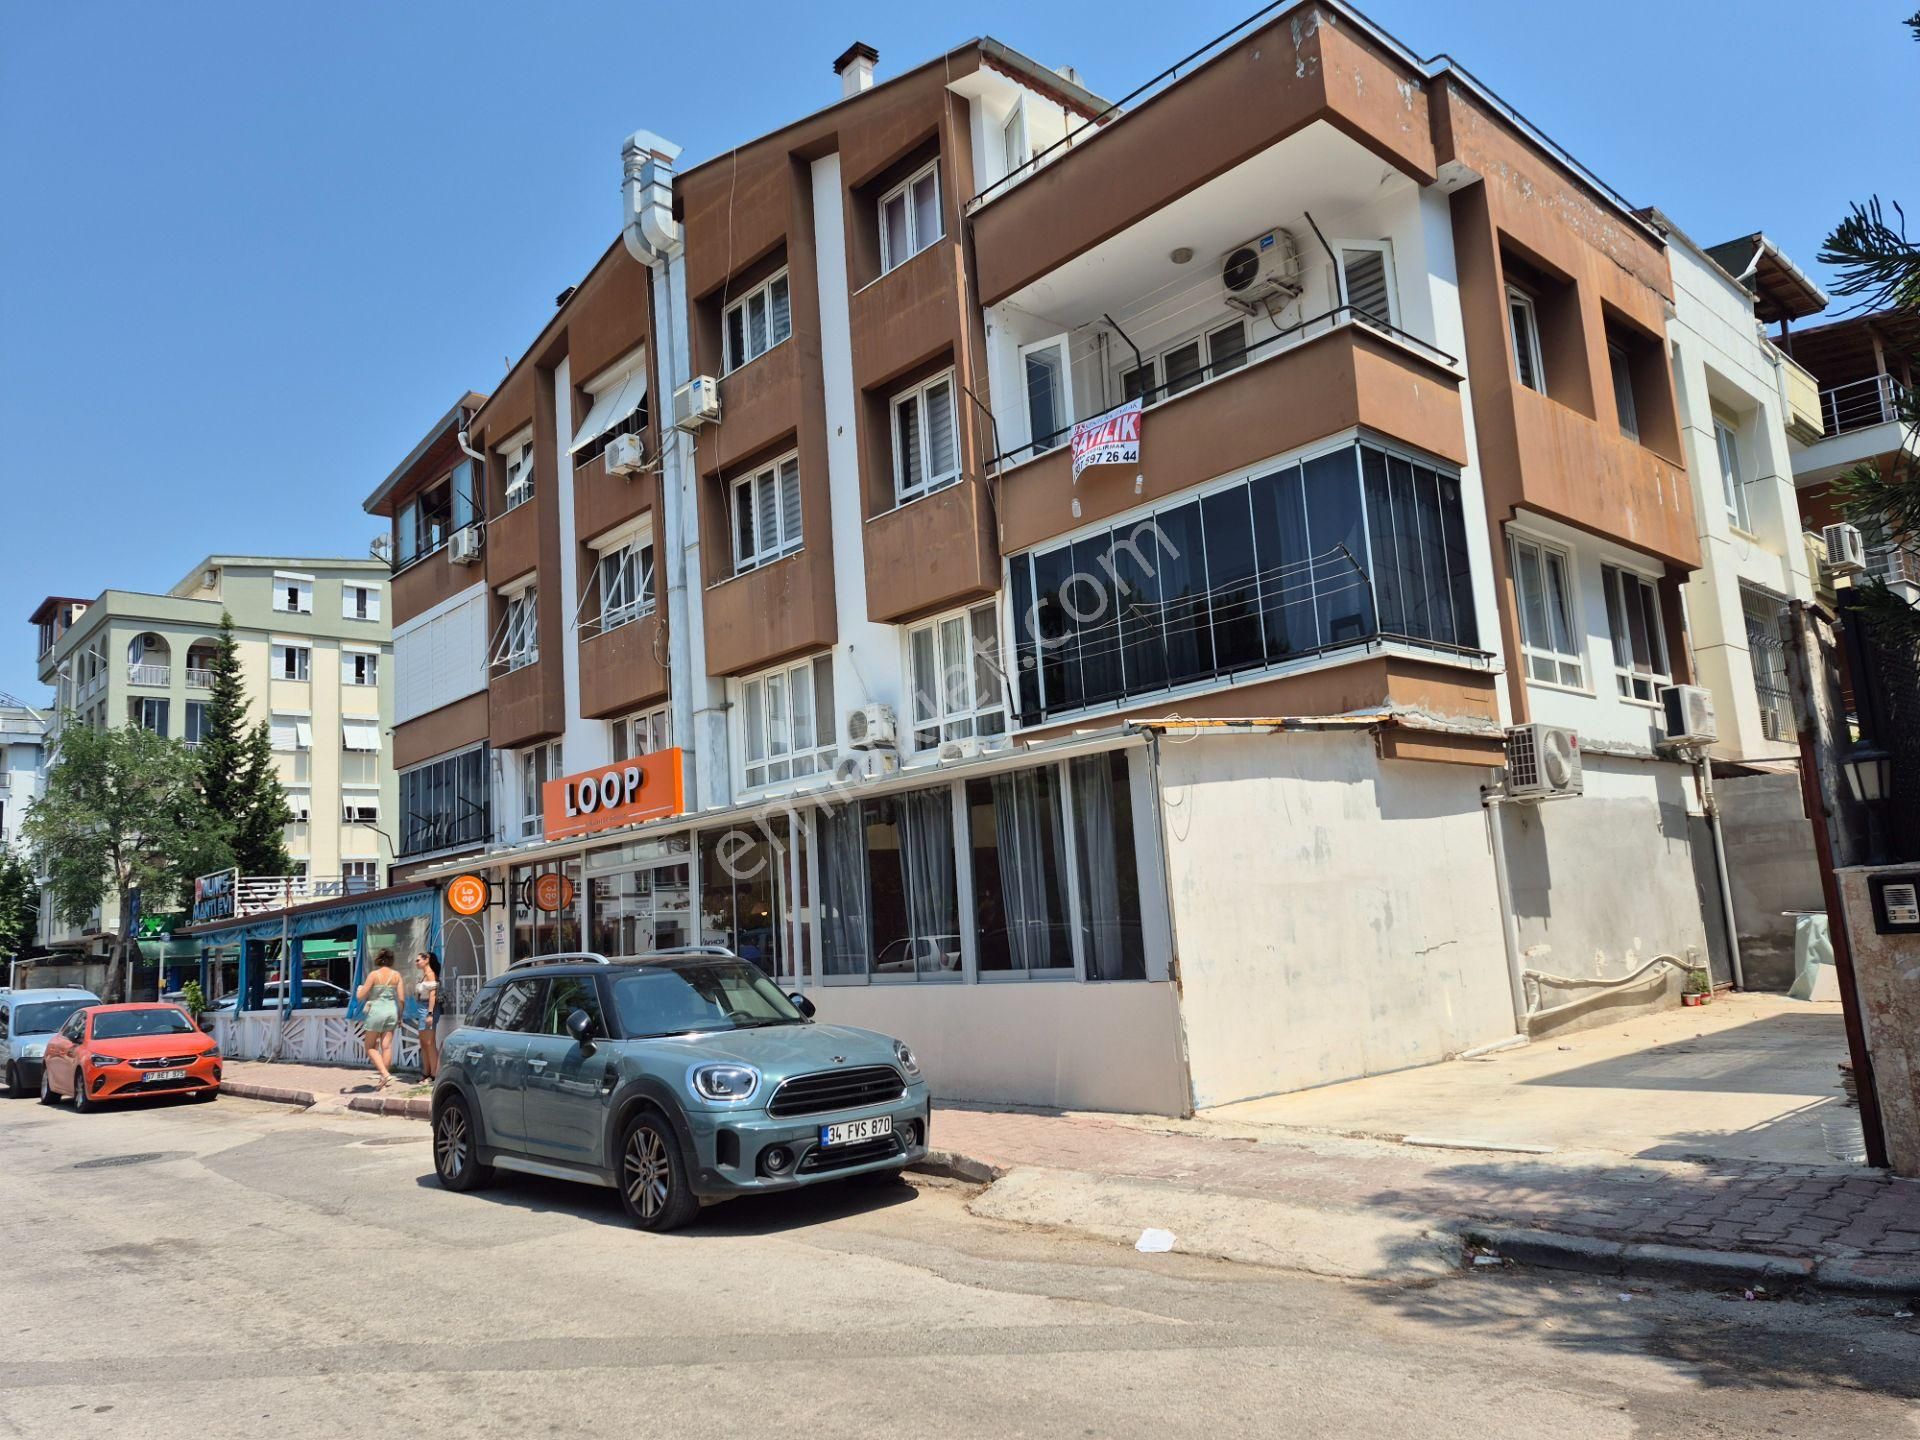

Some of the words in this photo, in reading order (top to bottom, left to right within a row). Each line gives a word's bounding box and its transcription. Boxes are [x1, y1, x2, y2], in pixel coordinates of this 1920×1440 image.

[1072, 414, 1138, 459] SATILIK
[1106, 451, 1119, 462] 26
[1123, 451, 1137, 462] 44
[565, 766, 644, 817] LOOP
[829, 1127, 841, 1142] 34
[848, 1122, 867, 1139] FVS
[871, 1117, 890, 1134] 870
